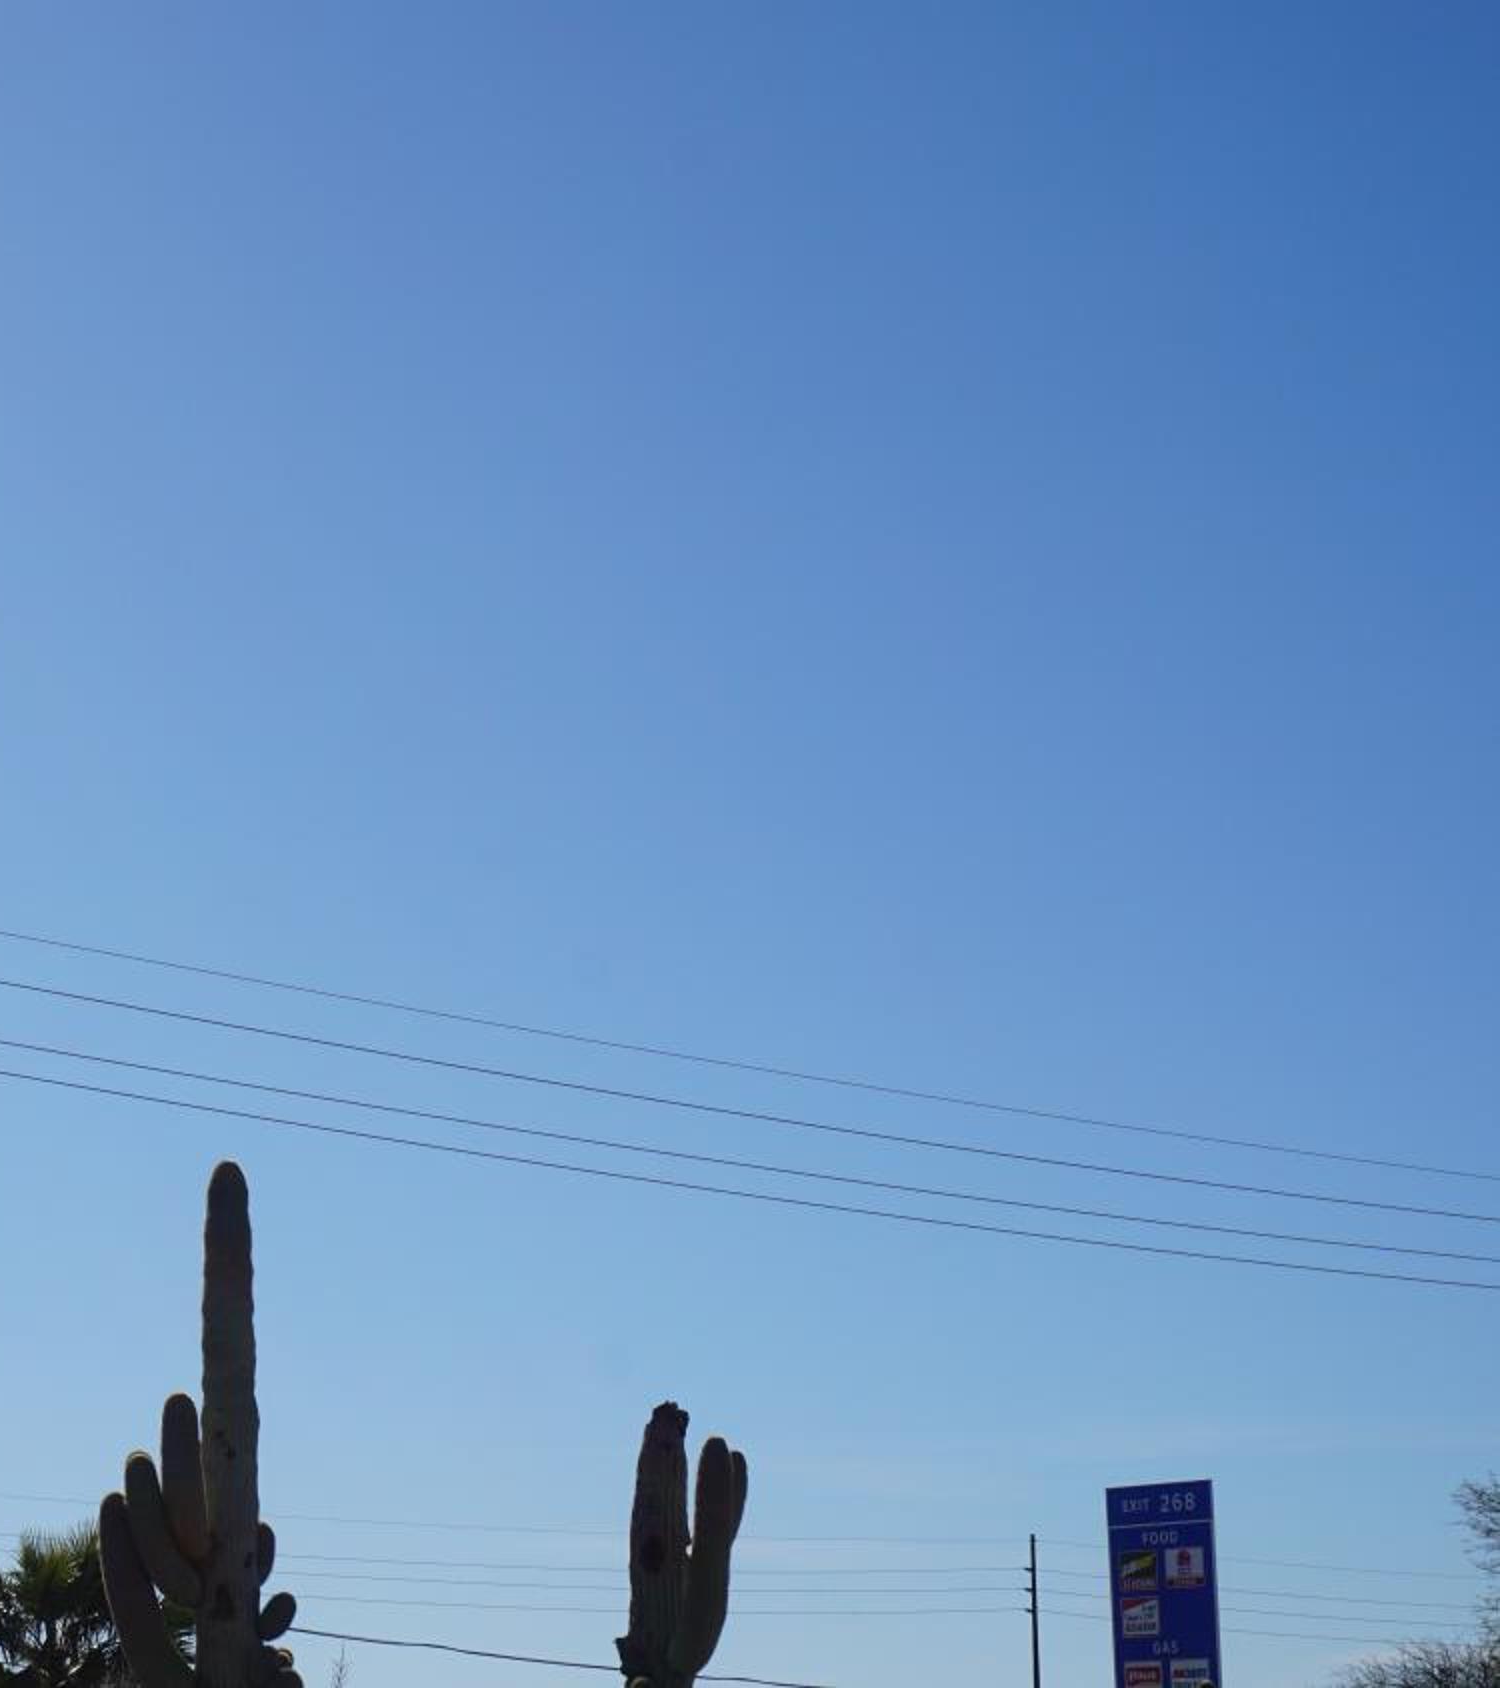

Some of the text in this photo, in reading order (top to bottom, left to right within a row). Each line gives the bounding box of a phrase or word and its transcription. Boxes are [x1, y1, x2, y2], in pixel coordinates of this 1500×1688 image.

[1122, 1492, 1197, 1514] EXIT 268
[1141, 1531, 1179, 1546] FOOD
[1152, 1641, 1180, 1656] GAS
